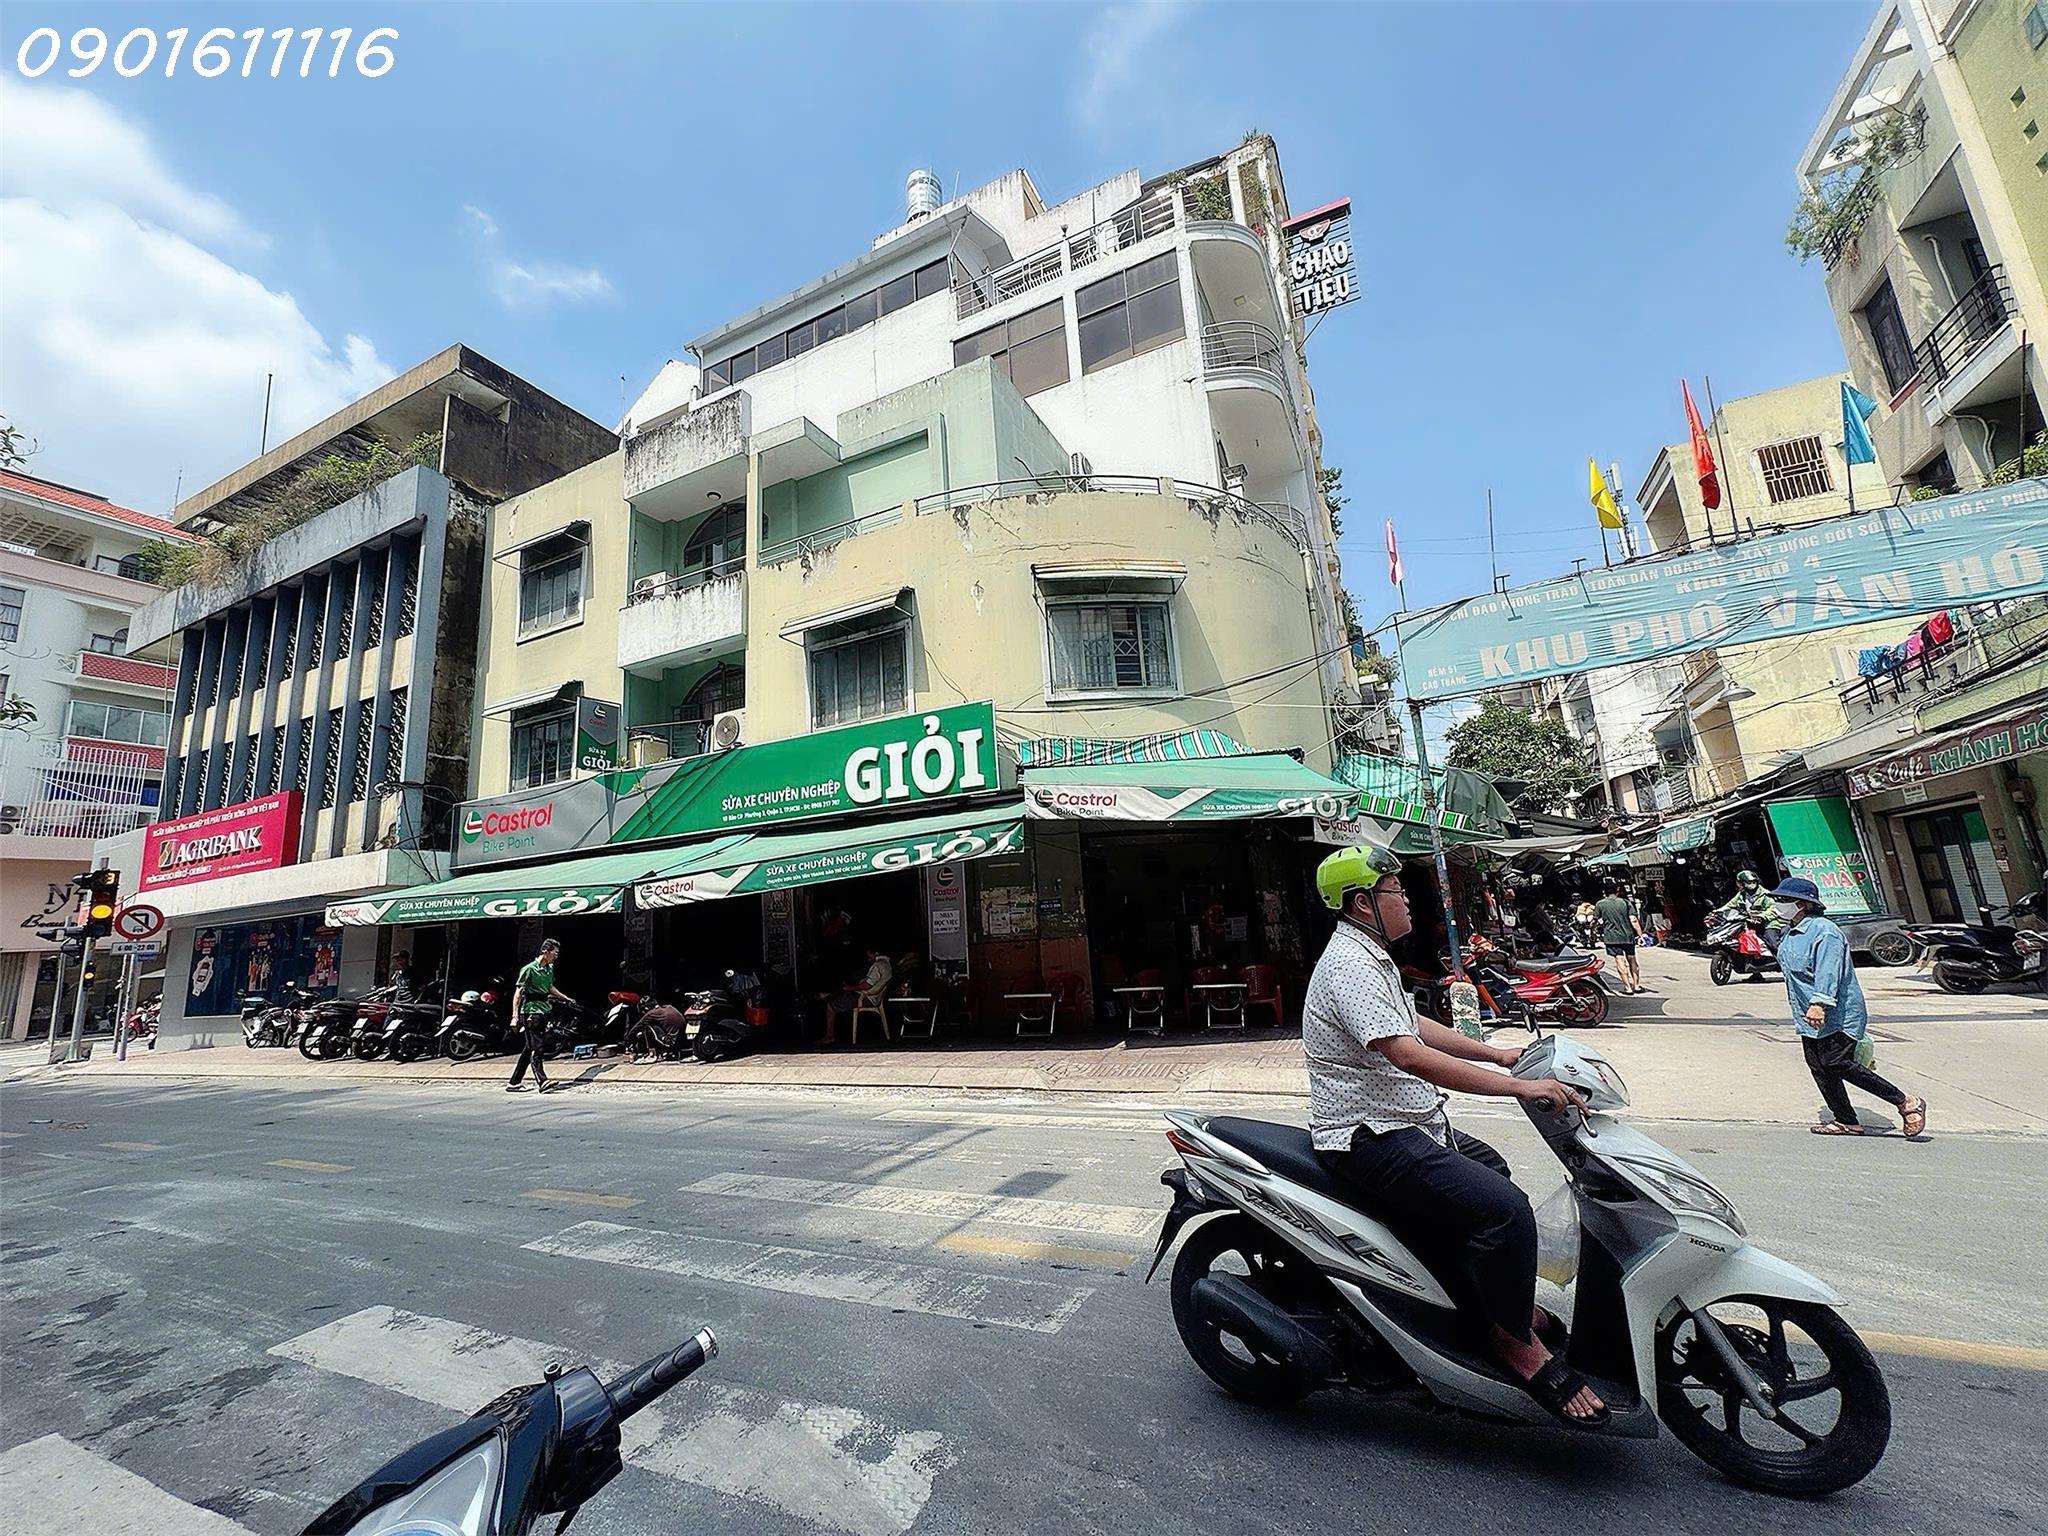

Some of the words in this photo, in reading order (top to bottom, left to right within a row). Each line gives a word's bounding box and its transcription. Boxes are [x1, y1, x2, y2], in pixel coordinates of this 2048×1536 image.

[1292, 240, 1348, 280] CHÁO
[1804, 555, 1821, 568] 4
[1502, 595, 1540, 609] PHONG
[1480, 630, 1587, 681] KHU
[1611, 592, 1728, 655] PHỐ
[1760, 569, 1912, 629] VĂN
[722, 794, 743, 811] SỬA
[743, 795, 756, 807] XE
[758, 786, 799, 805] CHUYÊN
[845, 715, 985, 804] GIỎI
[1928, 731, 2012, 776] KHÁNH
[1056, 793, 1117, 806] Castrol
[1057, 808, 1076, 816] Bike
[1079, 808, 1104, 816] Point
[484, 800, 553, 836] Castrol
[174, 826, 262, 864] AGRIBANK
[482, 841, 504, 854] Bike
[508, 836, 535, 850] Point
[766, 865, 784, 876] SỬA
[785, 864, 797, 873] XE
[798, 857, 834, 871] CHUYÊN
[871, 830, 1016, 870] GIỎI
[654, 880, 694, 896] Castrol
[414, 901, 423, 909] XE
[483, 890, 616, 916] GIỎI
[1690, 1238, 1726, 1253] HONDA
